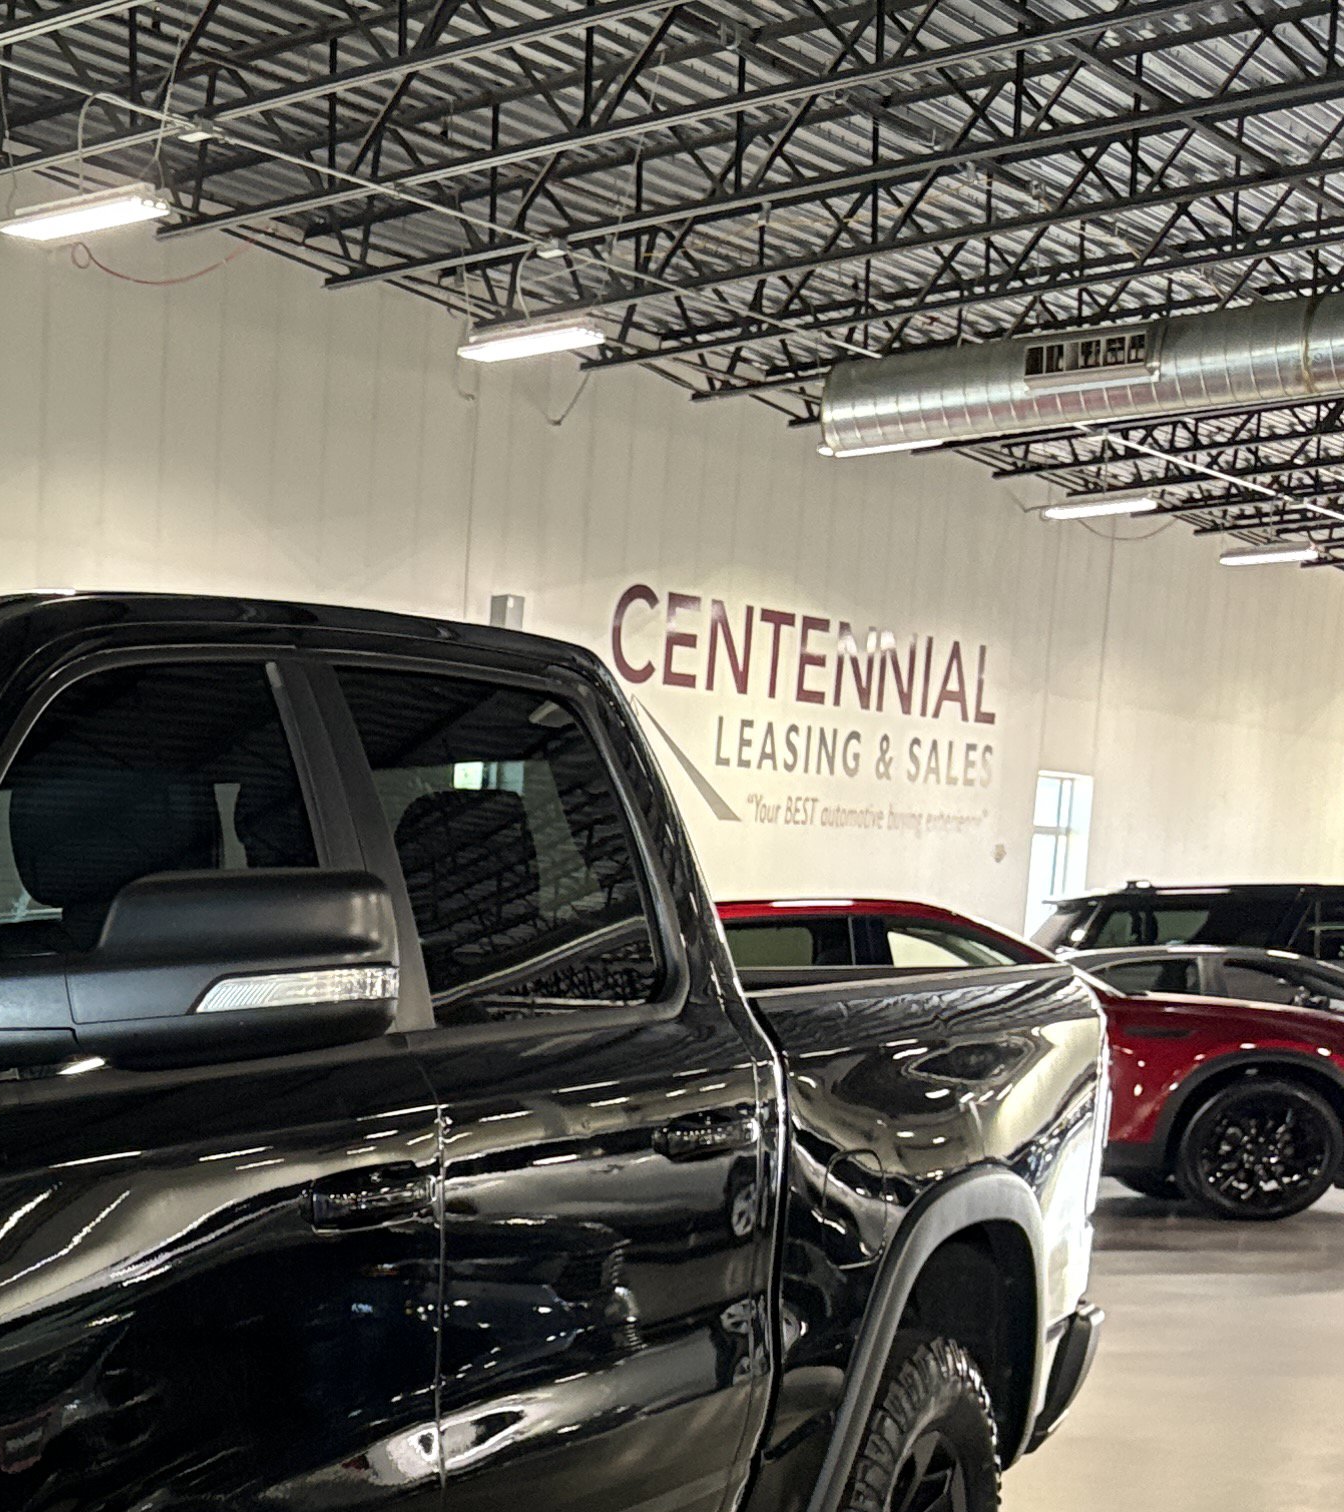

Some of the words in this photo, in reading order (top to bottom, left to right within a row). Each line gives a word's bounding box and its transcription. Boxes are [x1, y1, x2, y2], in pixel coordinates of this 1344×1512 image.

[612, 583, 996, 726] CENTENNIAL
[715, 715, 861, 778] LEASING
[875, 733, 893, 781] &
[906, 736, 994, 789] SALES
[784, 796, 819, 825] BEST
